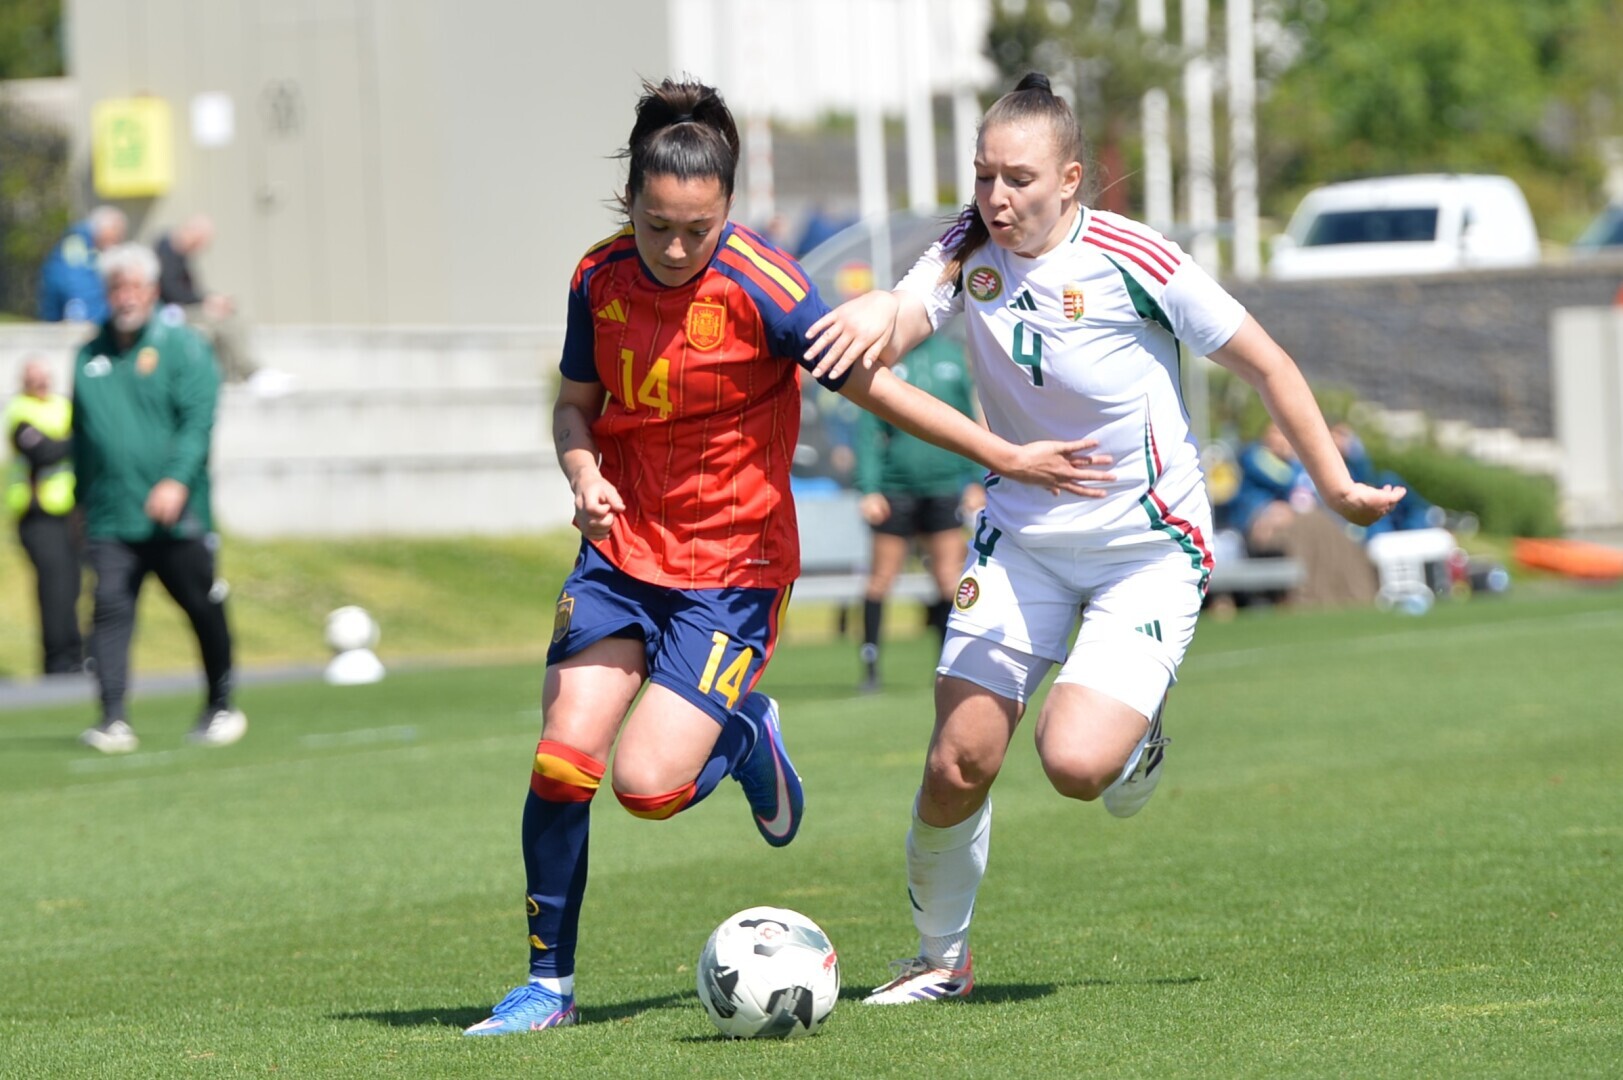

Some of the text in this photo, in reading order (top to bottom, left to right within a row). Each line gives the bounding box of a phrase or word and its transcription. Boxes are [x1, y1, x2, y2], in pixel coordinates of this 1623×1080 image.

[621, 348, 673, 420] 14
[1012, 321, 1044, 387] 4
[973, 515, 1002, 567] 4
[698, 630, 753, 710] 14
